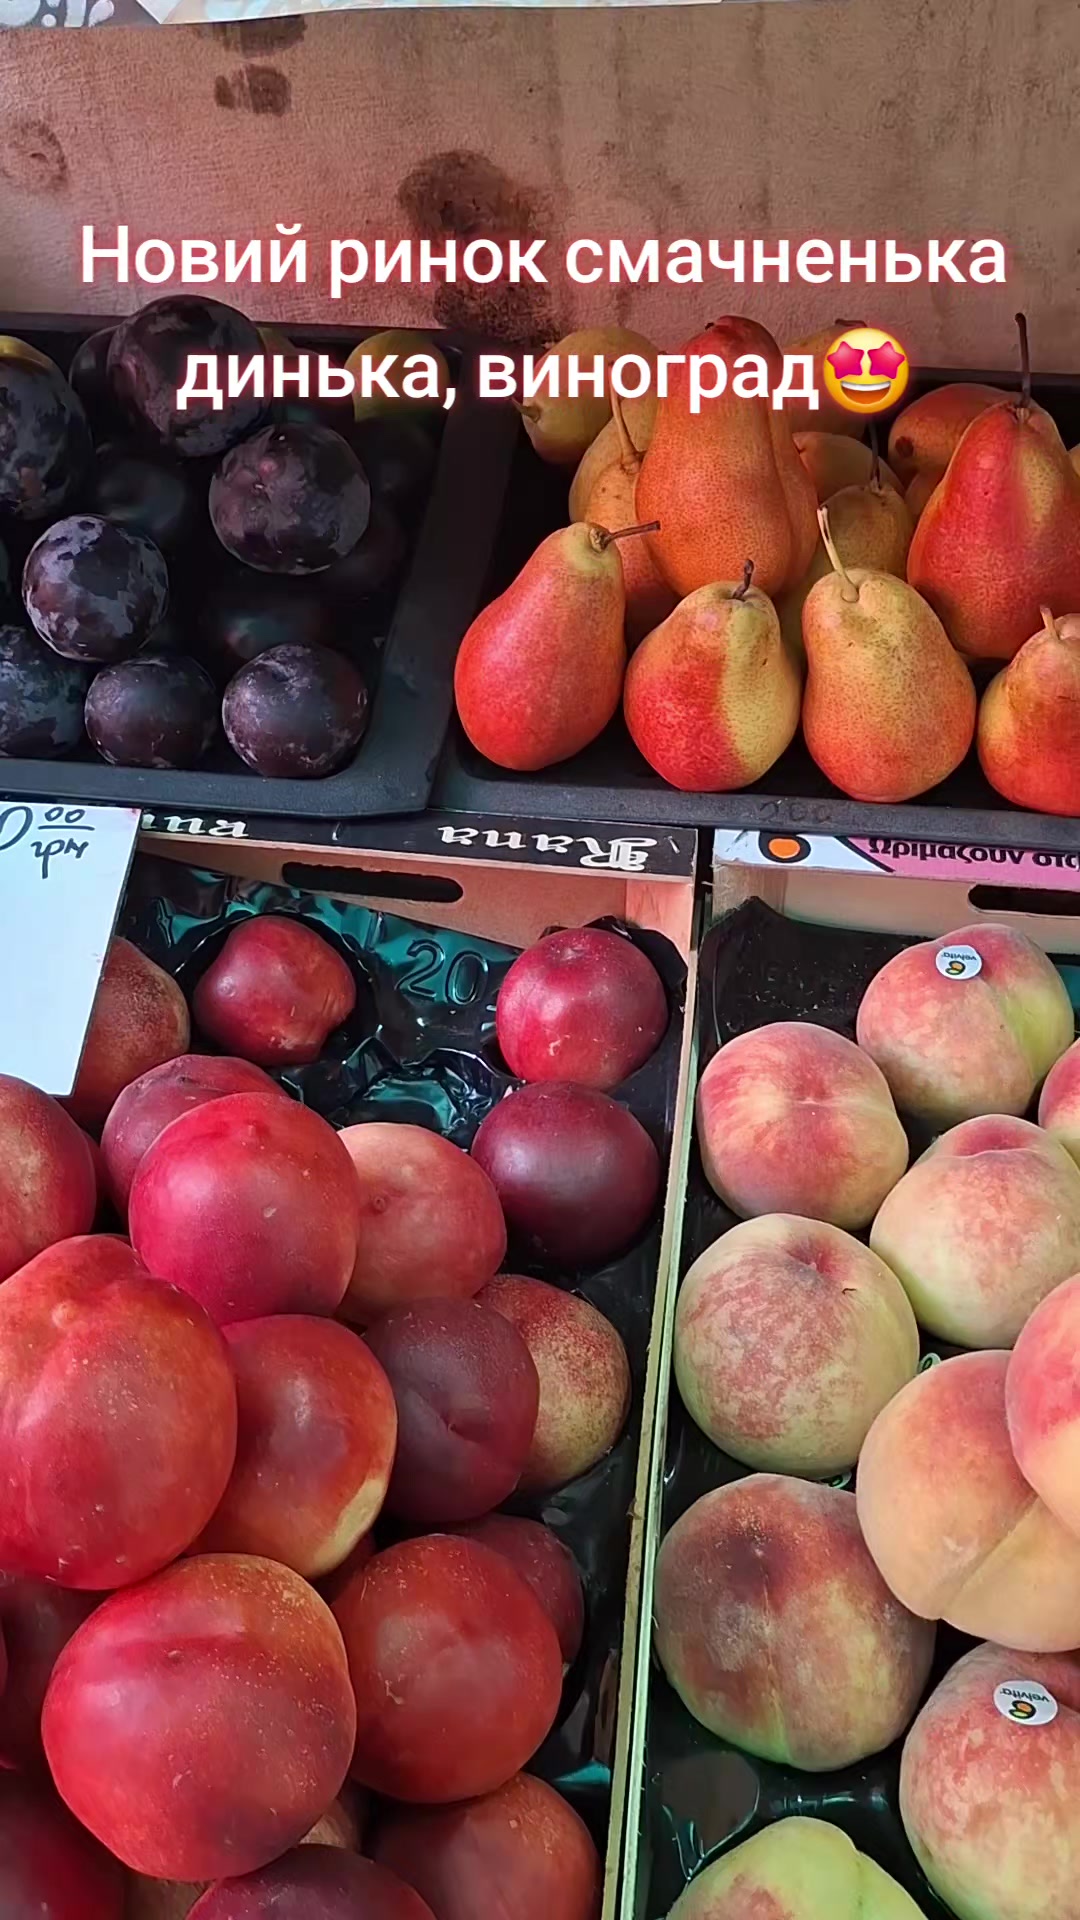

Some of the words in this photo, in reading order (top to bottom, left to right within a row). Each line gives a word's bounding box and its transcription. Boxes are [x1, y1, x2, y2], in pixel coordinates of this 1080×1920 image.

[942, 951, 978, 961] velvita
[395, 938, 489, 1005] 20
[1001, 1687, 1051, 1703] velvita
